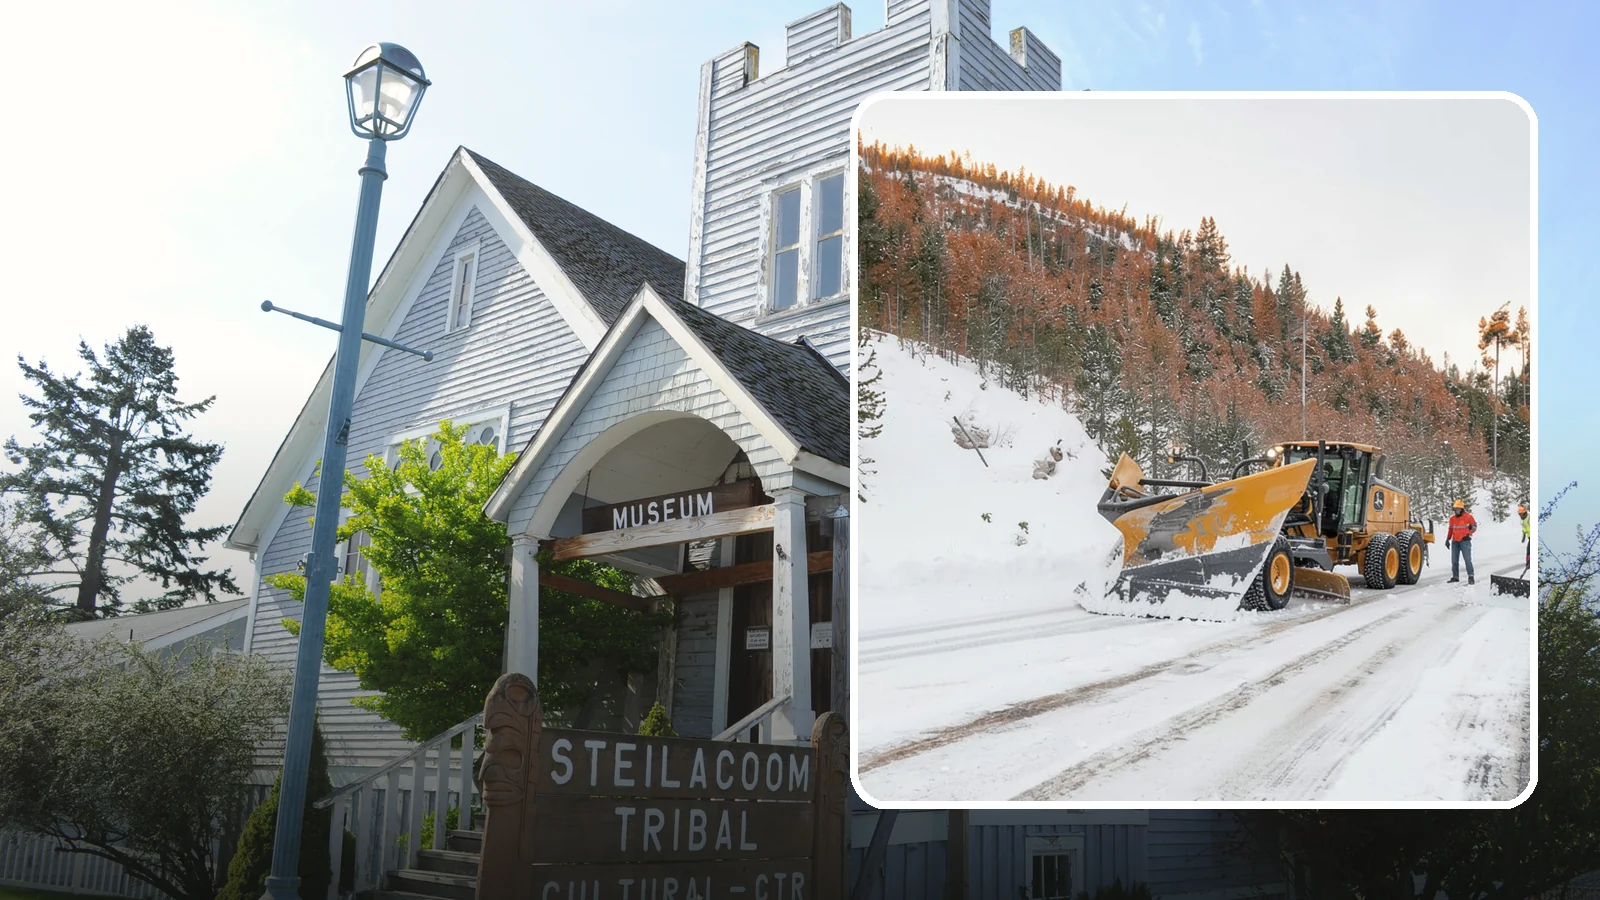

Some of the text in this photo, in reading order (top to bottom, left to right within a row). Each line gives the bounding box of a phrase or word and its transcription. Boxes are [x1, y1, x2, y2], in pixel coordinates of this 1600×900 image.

[612, 491, 714, 530] MUSEUM
[550, 738, 809, 793] STEILACOOM
[615, 806, 758, 851] TRIBAL
